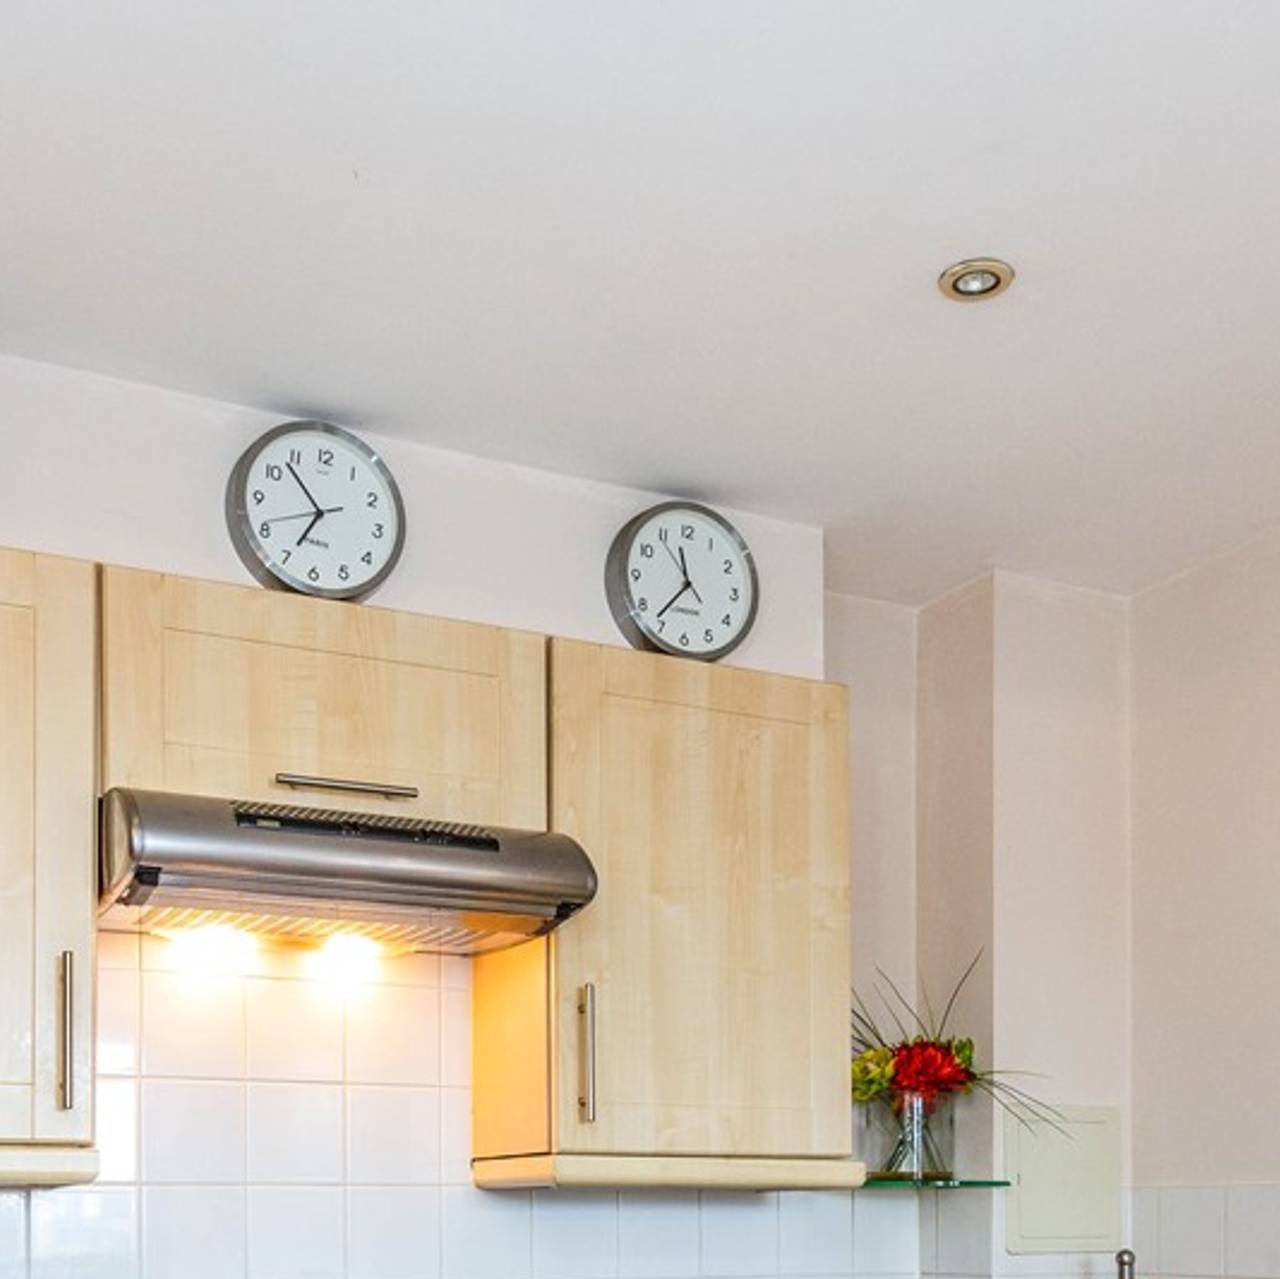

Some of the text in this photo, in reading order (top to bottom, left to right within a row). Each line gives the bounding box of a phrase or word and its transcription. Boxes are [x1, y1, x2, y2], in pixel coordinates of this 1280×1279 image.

[290, 450, 301, 464] 11
[318, 449, 334, 467] 12
[265, 465, 282, 481] 10
[253, 490, 265, 505] 9
[367, 492, 378, 508] 2
[259, 522, 271, 538] 8
[372, 523, 383, 539] 3
[659, 528, 667, 542] 11
[681, 525, 694, 541] 12
[282, 550, 291, 565] 7
[361, 551, 372, 565] 4
[640, 544, 653, 558] 10
[338, 565, 349, 580] 5
[724, 559, 733, 574] 2
[308, 567, 319, 582] 6
[631, 569, 641, 581] 9
[729, 588, 739, 601] 3
[638, 598, 648, 611] 8
[657, 620, 665, 633] 7
[722, 614, 730, 627] 4
[679, 633, 689, 646] 6
[704, 629, 714, 643] 5
